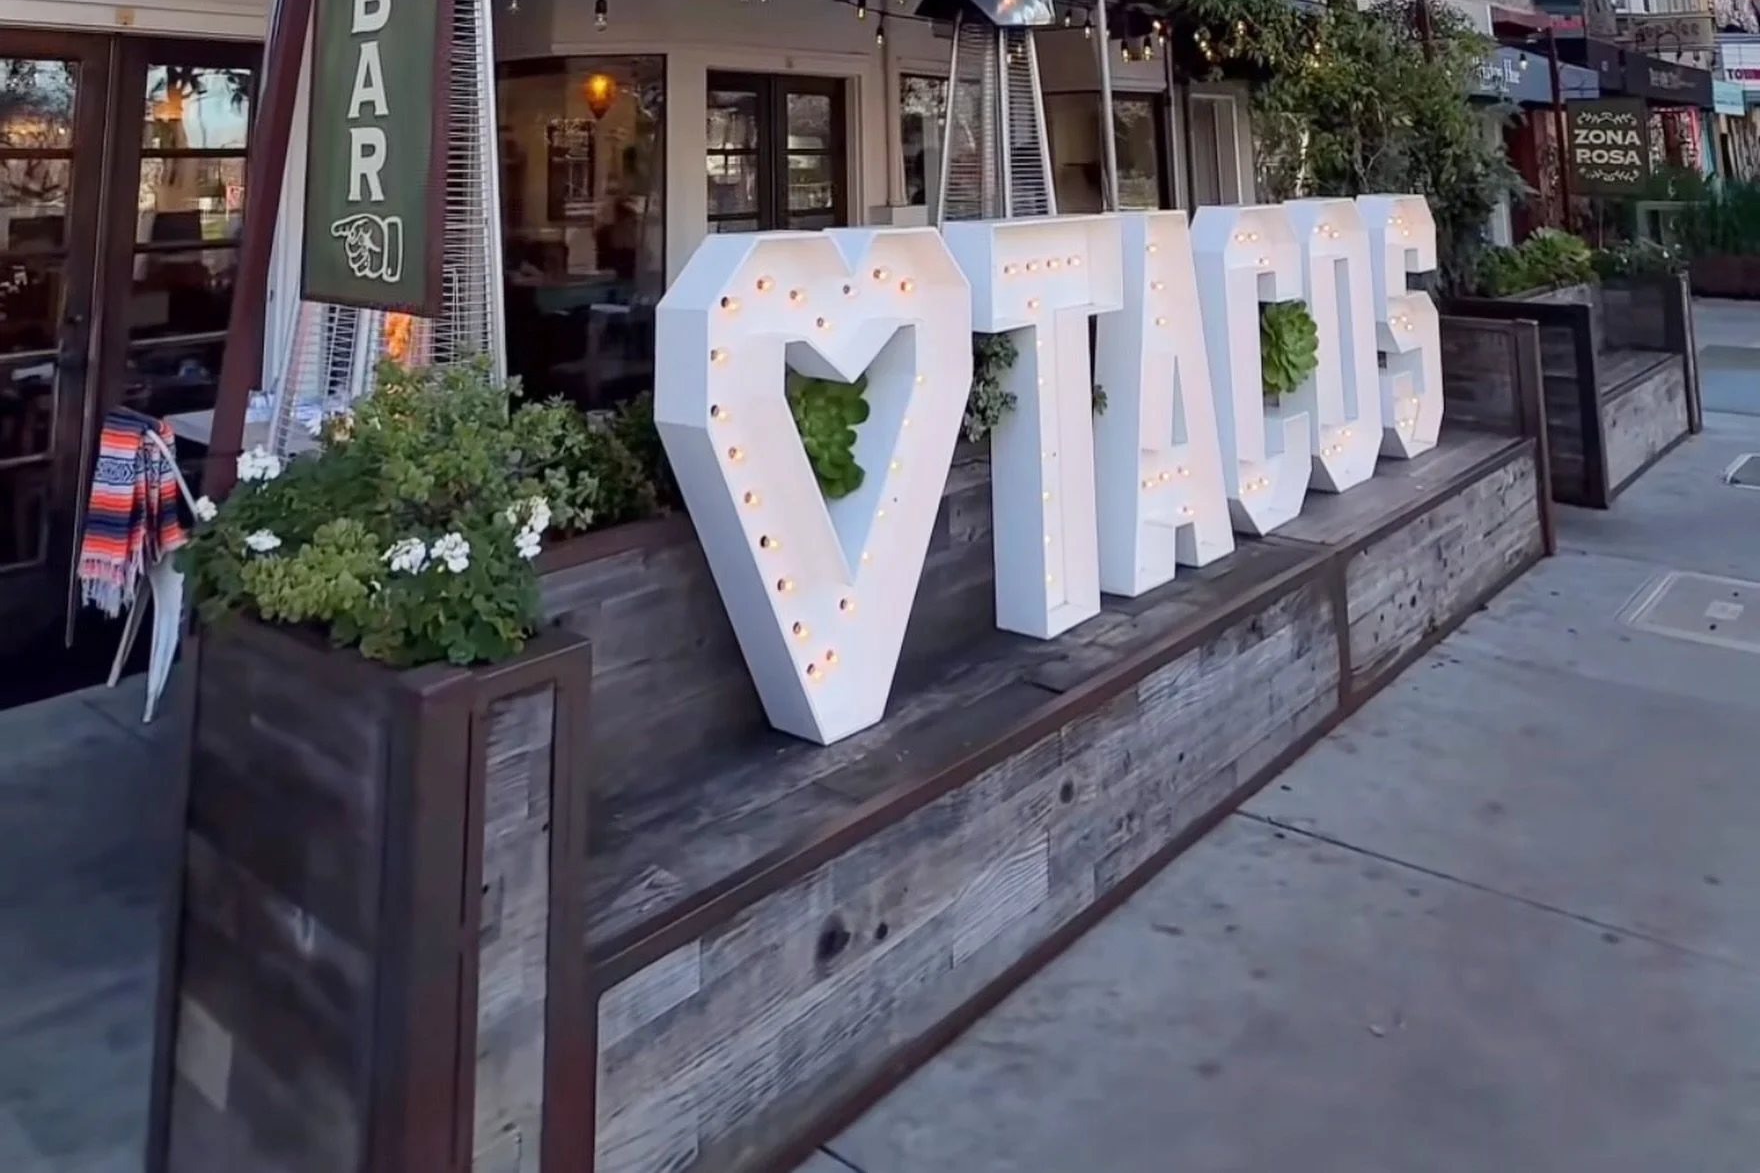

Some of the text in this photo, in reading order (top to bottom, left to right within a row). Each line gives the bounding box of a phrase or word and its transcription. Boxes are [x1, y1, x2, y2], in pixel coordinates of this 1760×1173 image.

[1574, 129, 1641, 146] ZONA
[1575, 149, 1642, 166] ROSA
[942, 192, 1443, 639] TACOS
